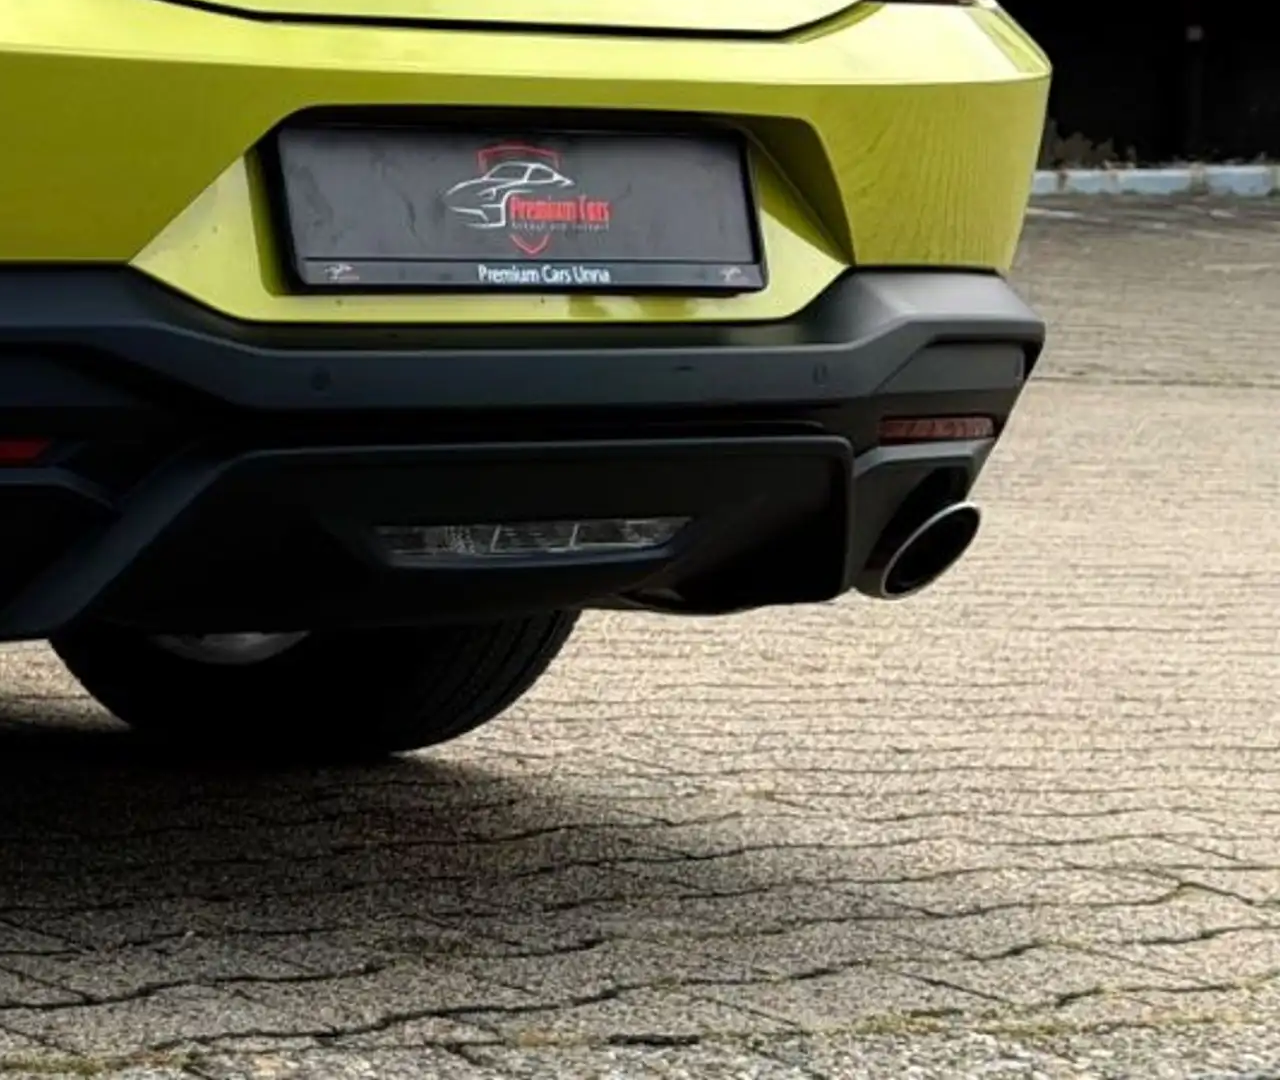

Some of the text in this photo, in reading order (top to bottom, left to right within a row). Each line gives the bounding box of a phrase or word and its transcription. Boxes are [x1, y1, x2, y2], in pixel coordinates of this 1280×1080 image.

[510, 196, 576, 223] Premium
[478, 264, 611, 284] Premium Cars Unna
